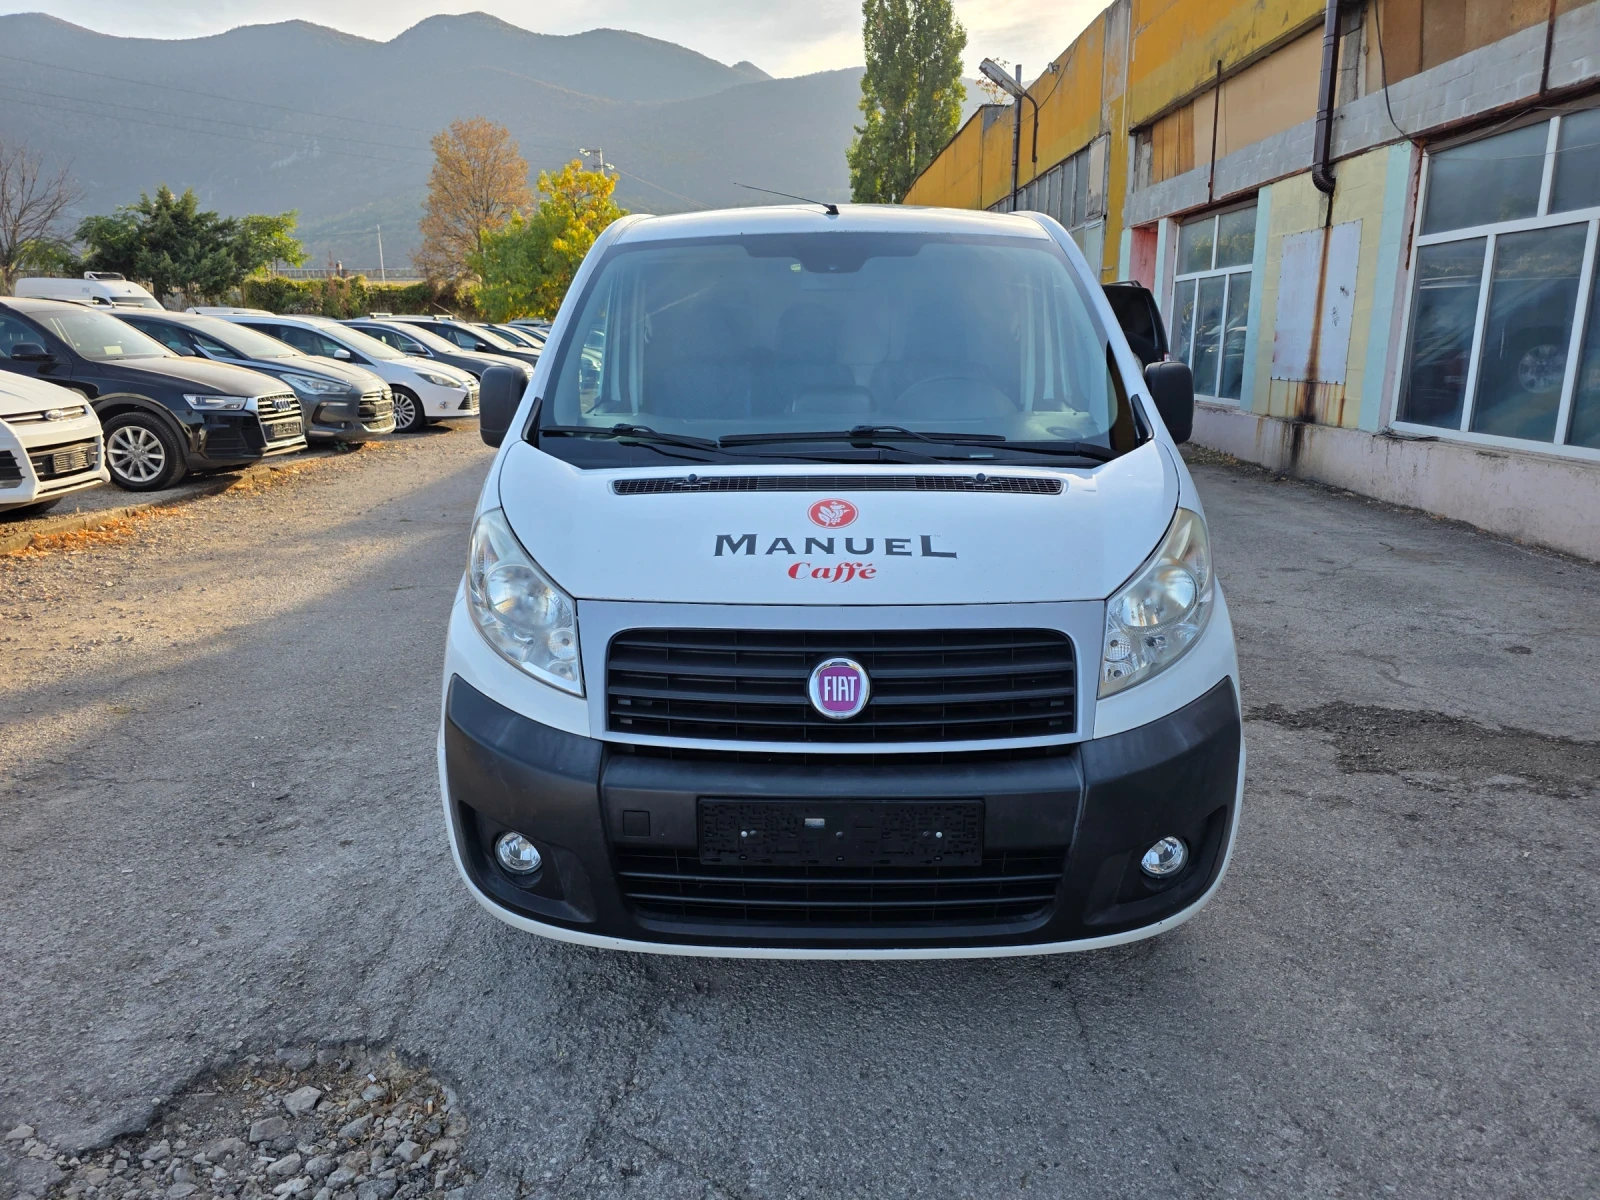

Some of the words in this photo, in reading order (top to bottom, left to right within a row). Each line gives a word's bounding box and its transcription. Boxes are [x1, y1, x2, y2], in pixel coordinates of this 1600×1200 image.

[713, 533, 958, 559] MANUEL
[788, 561, 877, 583] Caffé
[824, 676, 857, 702] FIAT
